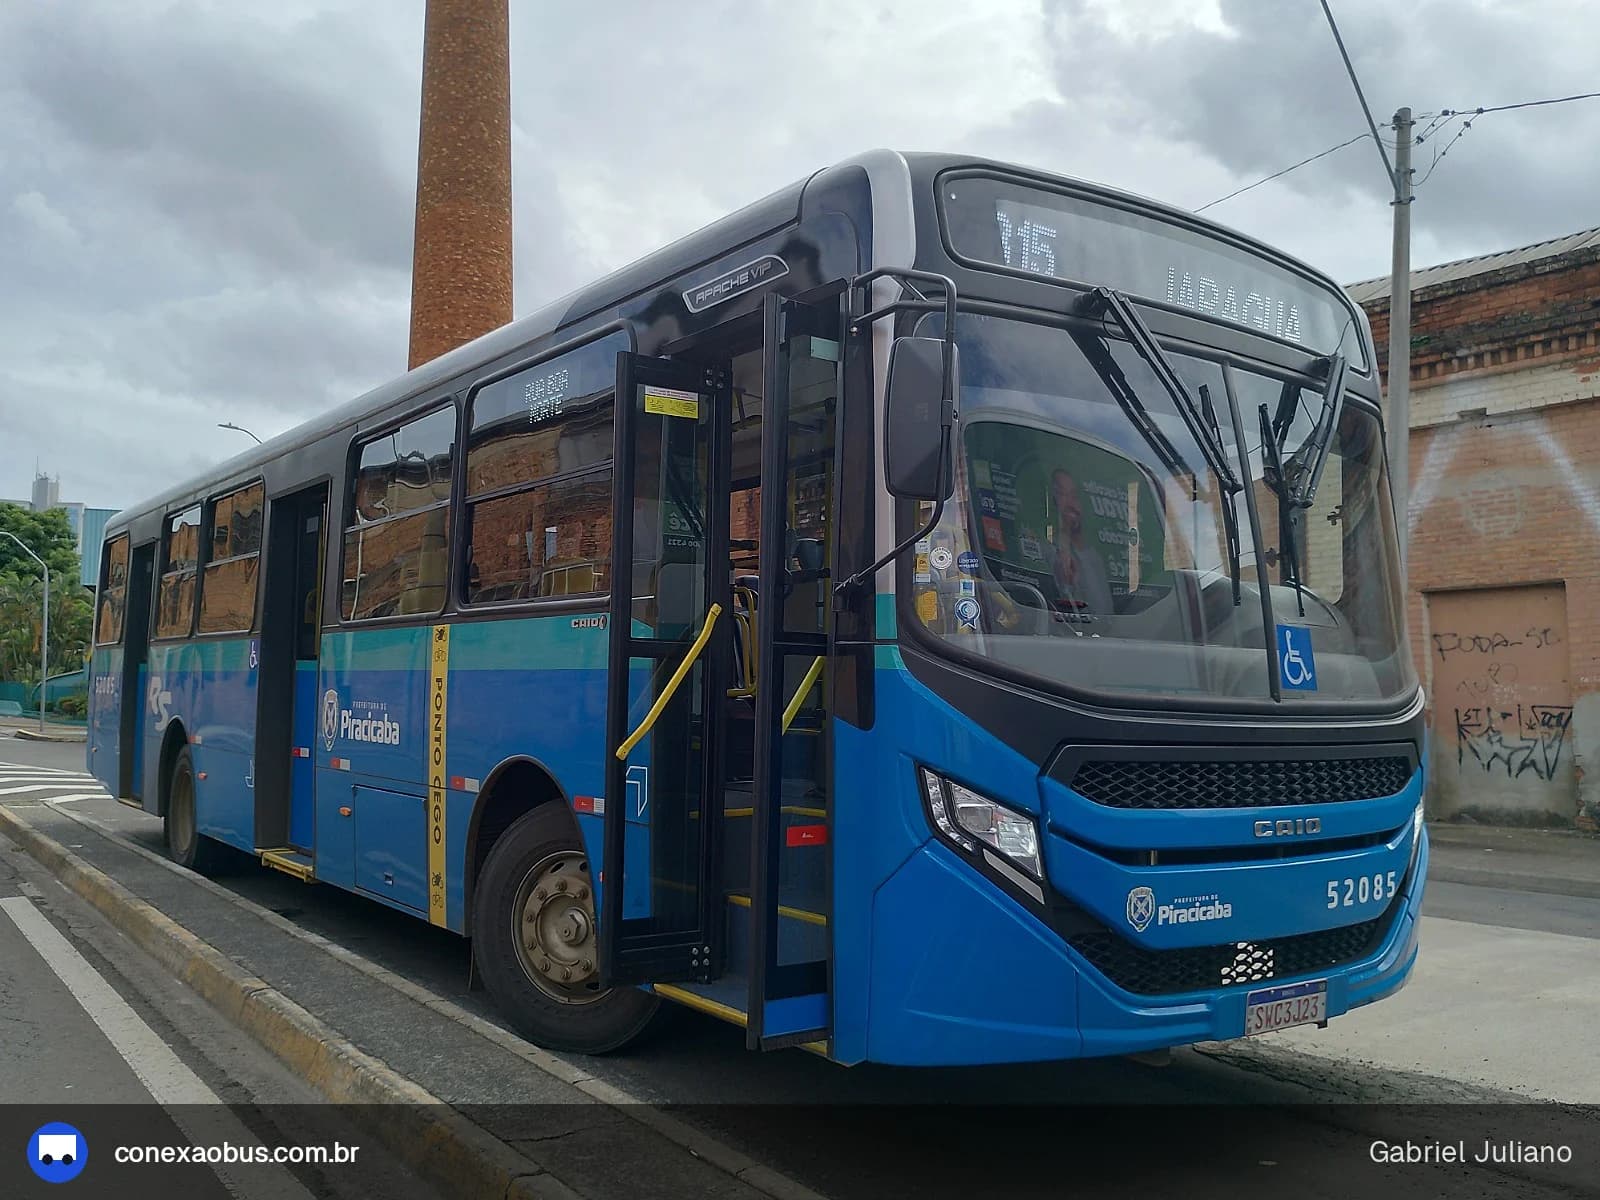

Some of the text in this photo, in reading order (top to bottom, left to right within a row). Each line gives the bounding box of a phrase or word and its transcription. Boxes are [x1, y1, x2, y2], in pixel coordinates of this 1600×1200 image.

[695, 261, 772, 305] APACHE VIP
[571, 617, 599, 628] CAIO
[340, 709, 400, 745] Piracicaba
[433, 677, 443, 845] PONTO CEGO
[1254, 817, 1321, 837] CAIO
[1174, 895, 1209, 904] PREFEITURA
[1327, 871, 1396, 910] 52085
[1158, 900, 1232, 926] Piracicaba
[1255, 995, 1319, 1030] SWC3J23
